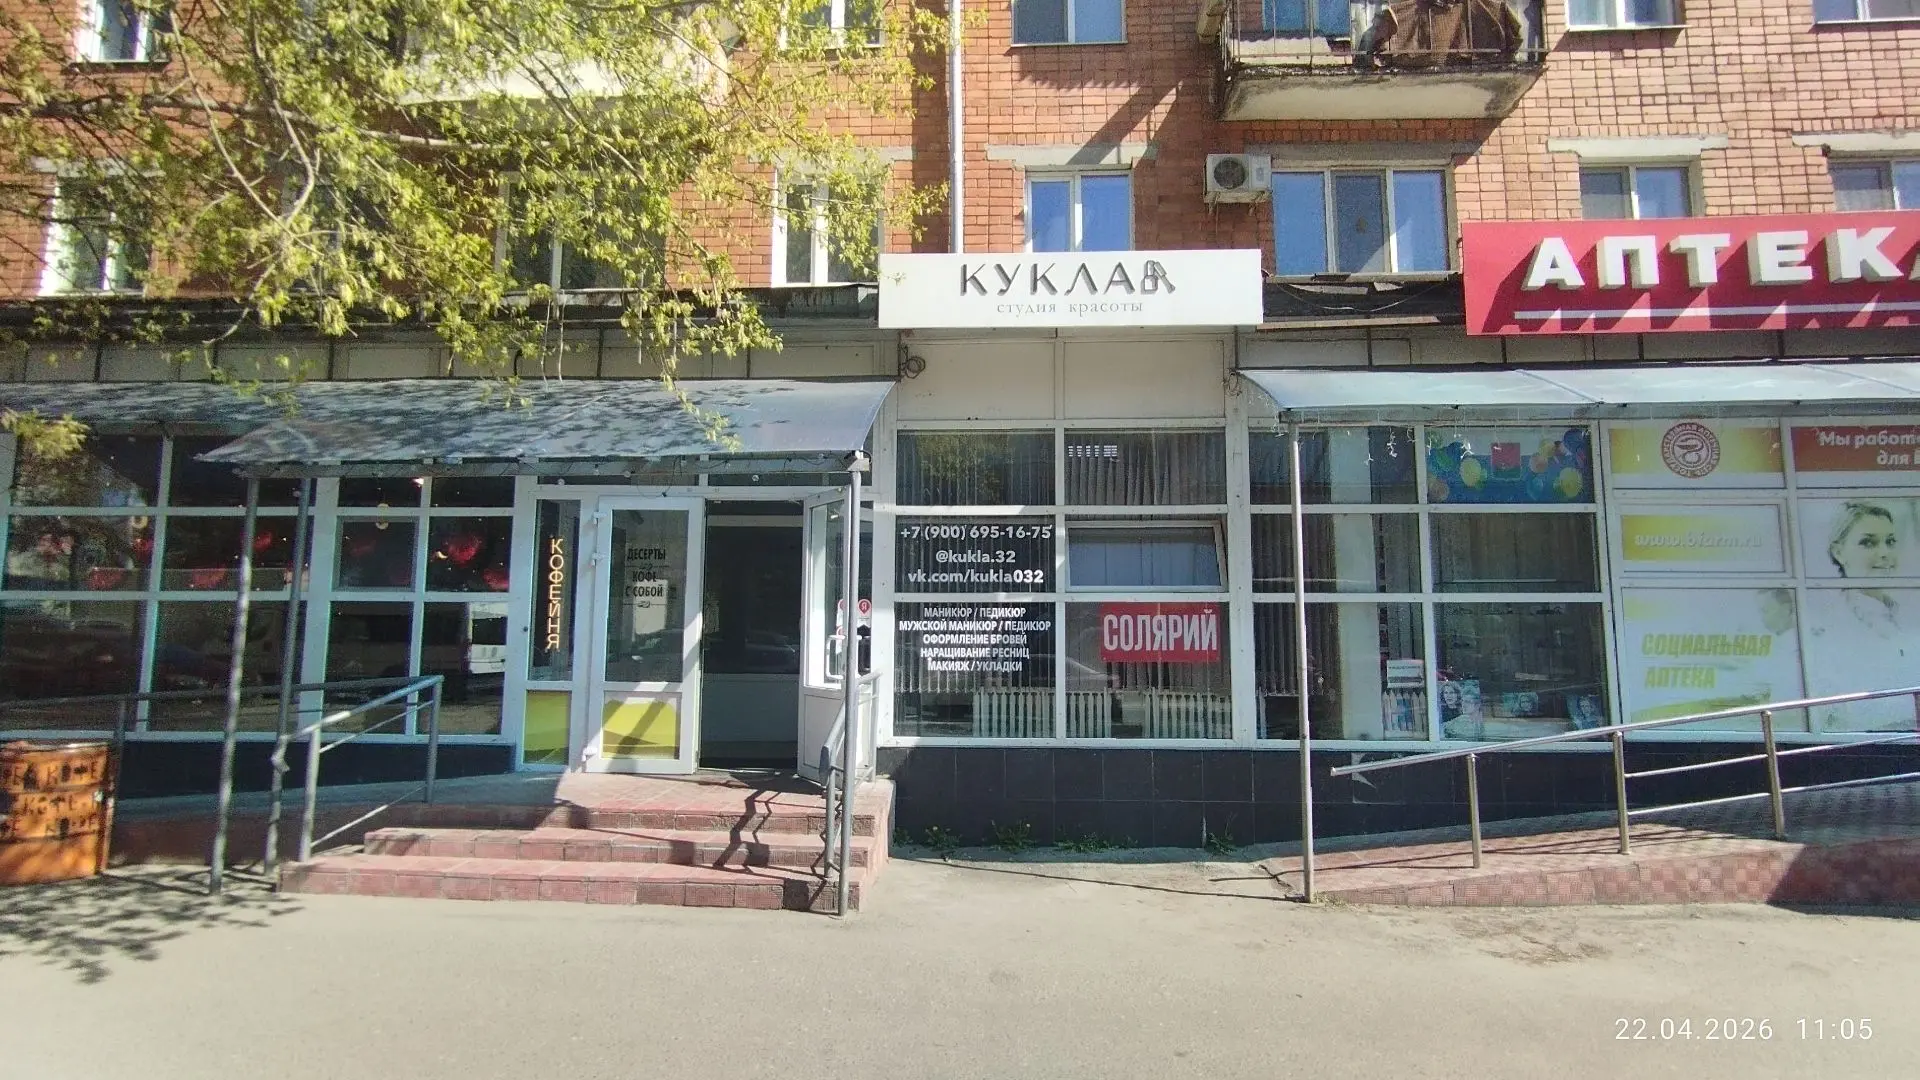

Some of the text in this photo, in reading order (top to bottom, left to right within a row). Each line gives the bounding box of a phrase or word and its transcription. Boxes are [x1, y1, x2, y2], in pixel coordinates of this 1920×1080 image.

[1521, 226, 1920, 290] АПТЕК
[960, 261, 1136, 296] КУКЛА
[997, 300, 1143, 317] студия красоты
[1820, 431, 1850, 446] Мы
[1877, 449, 1909, 465] для
[901, 525, 1051, 540] +7 (900) 695-16-75
[627, 548, 666, 561] ДЕСЕРТЫ
[936, 550, 1016, 563] @kukla.32
[632, 571, 656, 583] КОФЕ
[908, 569, 1044, 583] vk.com/kukla032
[546, 538, 564, 650] КОФЕЙНЯ
[626, 584, 663, 597] С СОБОЙ
[924, 607, 972, 618] МАНИКЮР
[980, 607, 1026, 619] ПЕДИКЮР
[899, 619, 947, 631] МУЖСКОЙ
[949, 620, 997, 631] МАНИКЮР
[1005, 620, 1051, 632] ПЕДИКЮР
[1103, 609, 1218, 651] СОЛЯРИЙ
[923, 632, 1027, 645] ОФОРМЛЕНИЕ БРОВЕЙ
[1642, 633, 1773, 658] СОЦИАЛЬНАЯ
[920, 648, 1029, 660] НАРАЩИВАНИЕ РЕСНИЦ
[928, 660, 969, 671] МАКИЯЖ
[976, 660, 1022, 673] УКЛАДКИ
[1645, 666, 1716, 688] АПТЕКА
